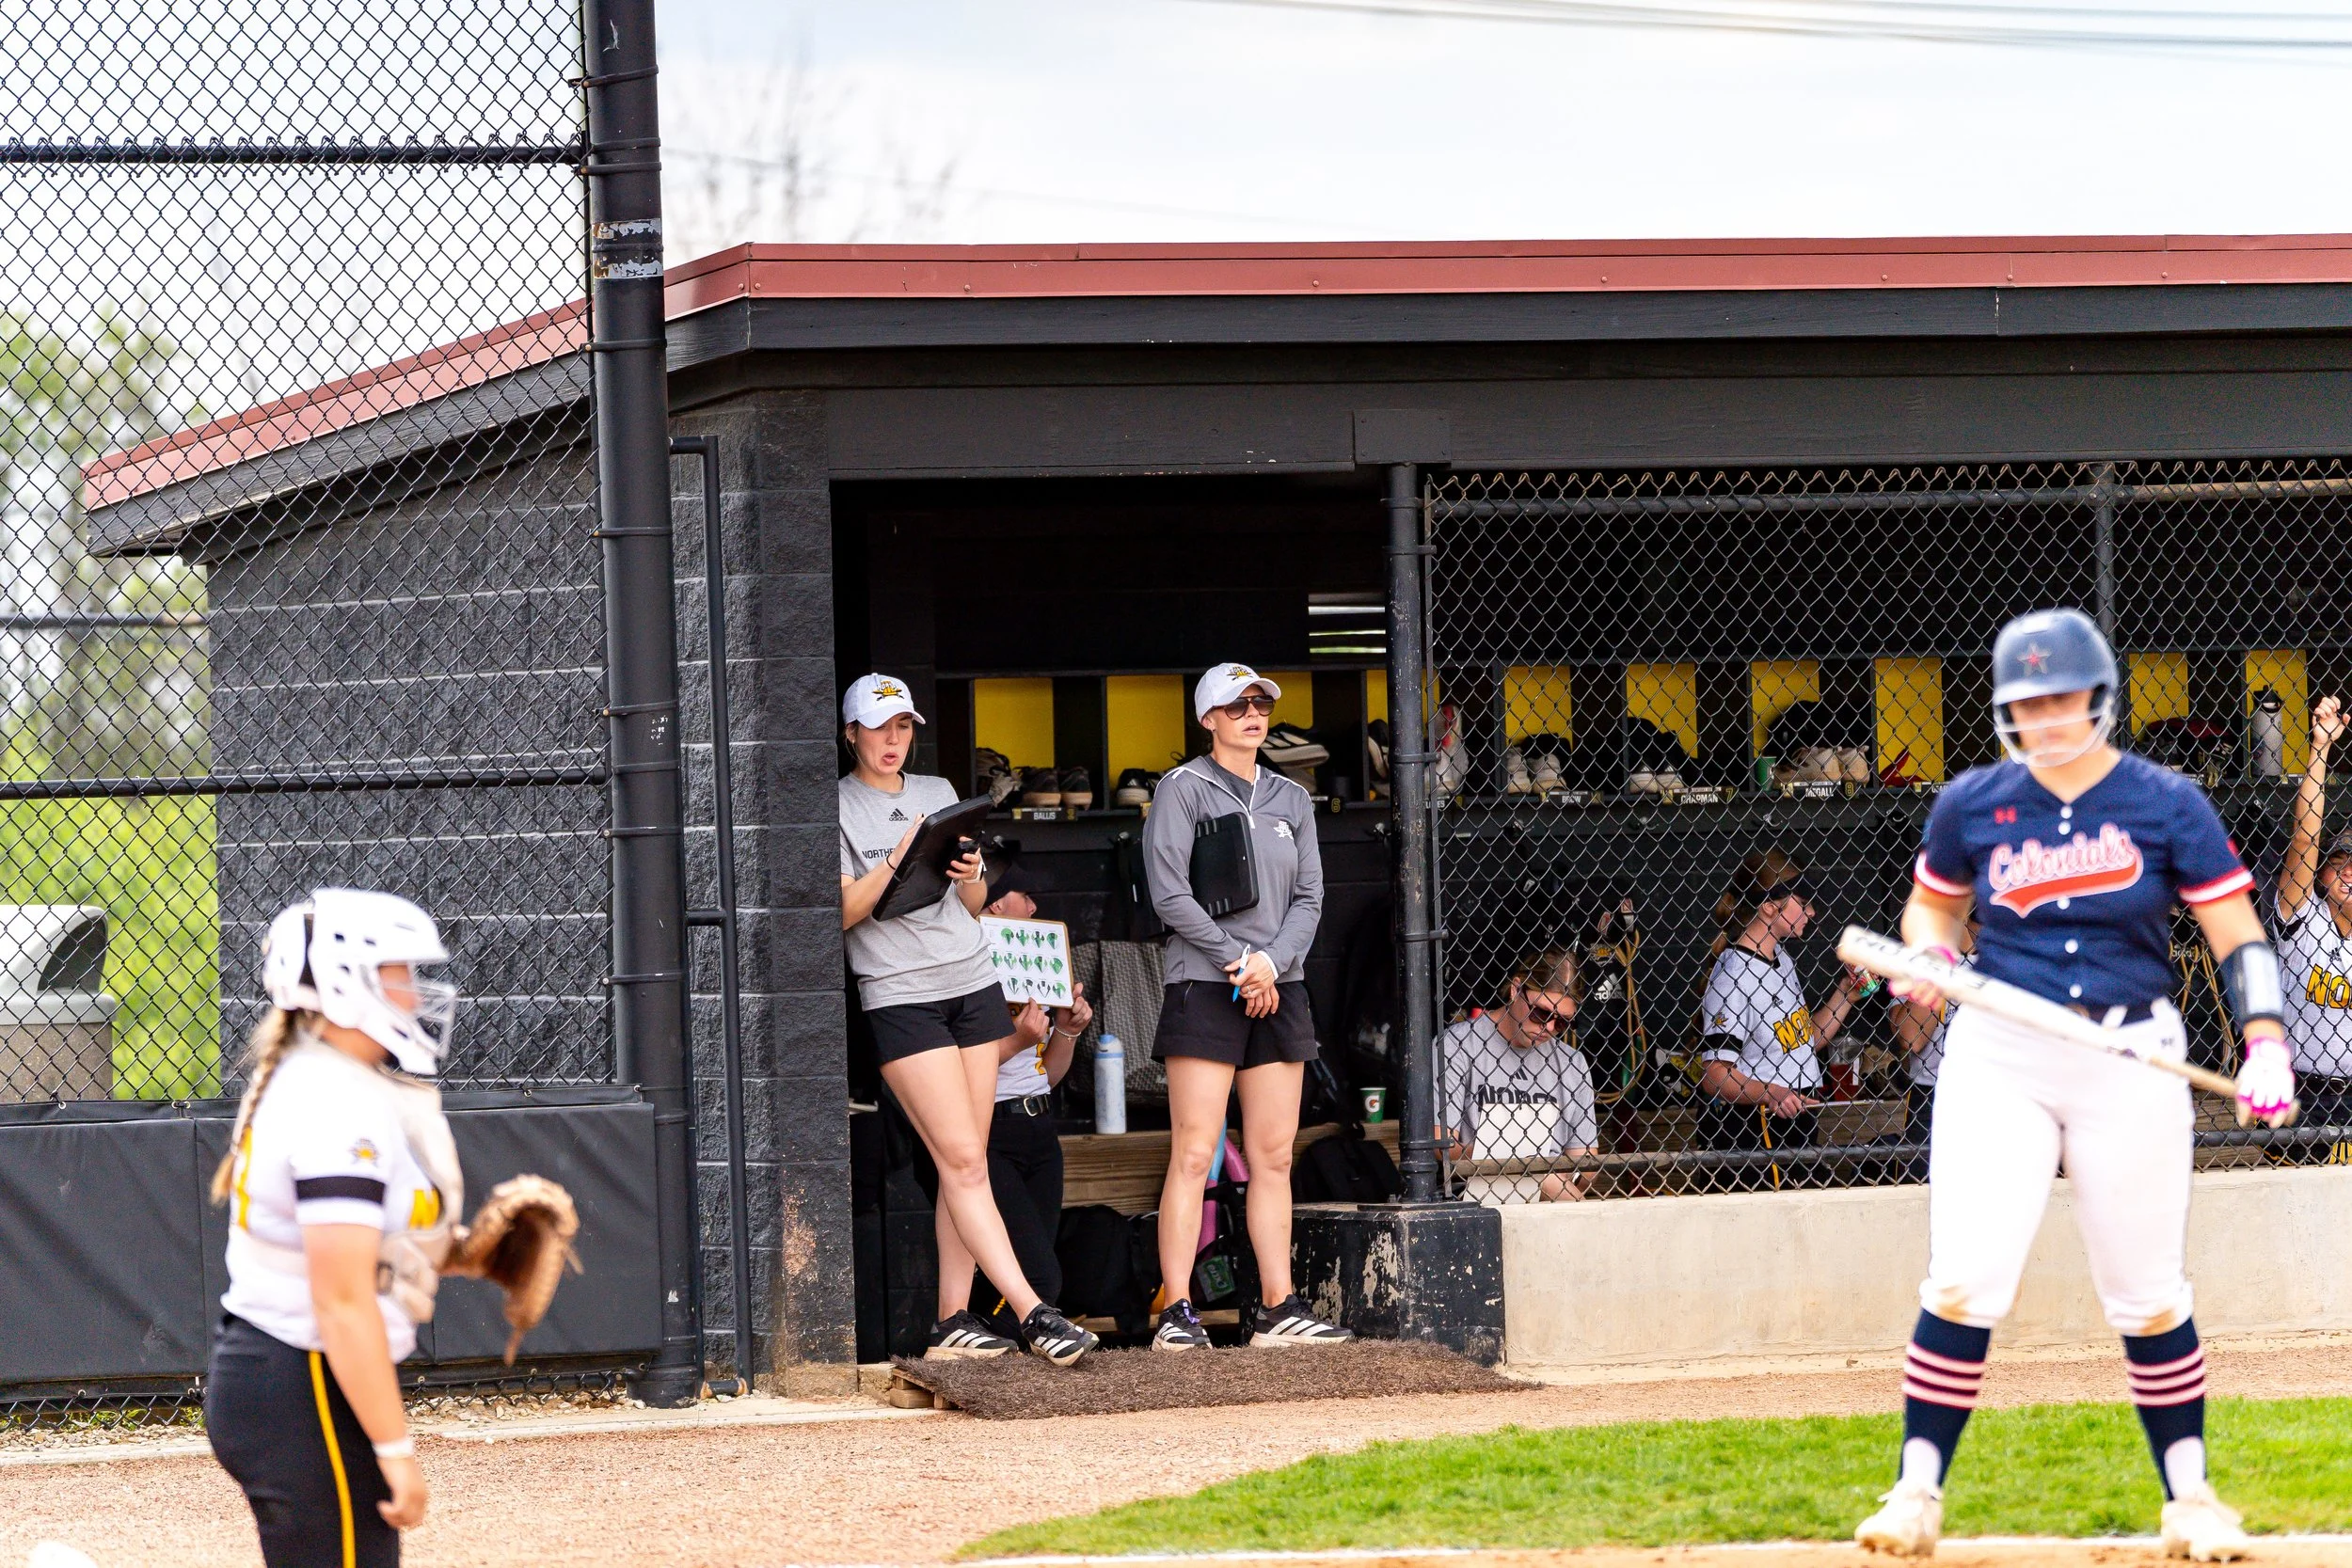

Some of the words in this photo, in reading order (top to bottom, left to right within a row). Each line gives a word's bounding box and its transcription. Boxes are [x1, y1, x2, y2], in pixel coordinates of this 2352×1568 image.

[862, 847, 897, 860] NORTHE
[1989, 822, 2141, 892] Colonials
[2305, 963, 2352, 1009] NO
[1365, 1095, 1380, 1113] G
